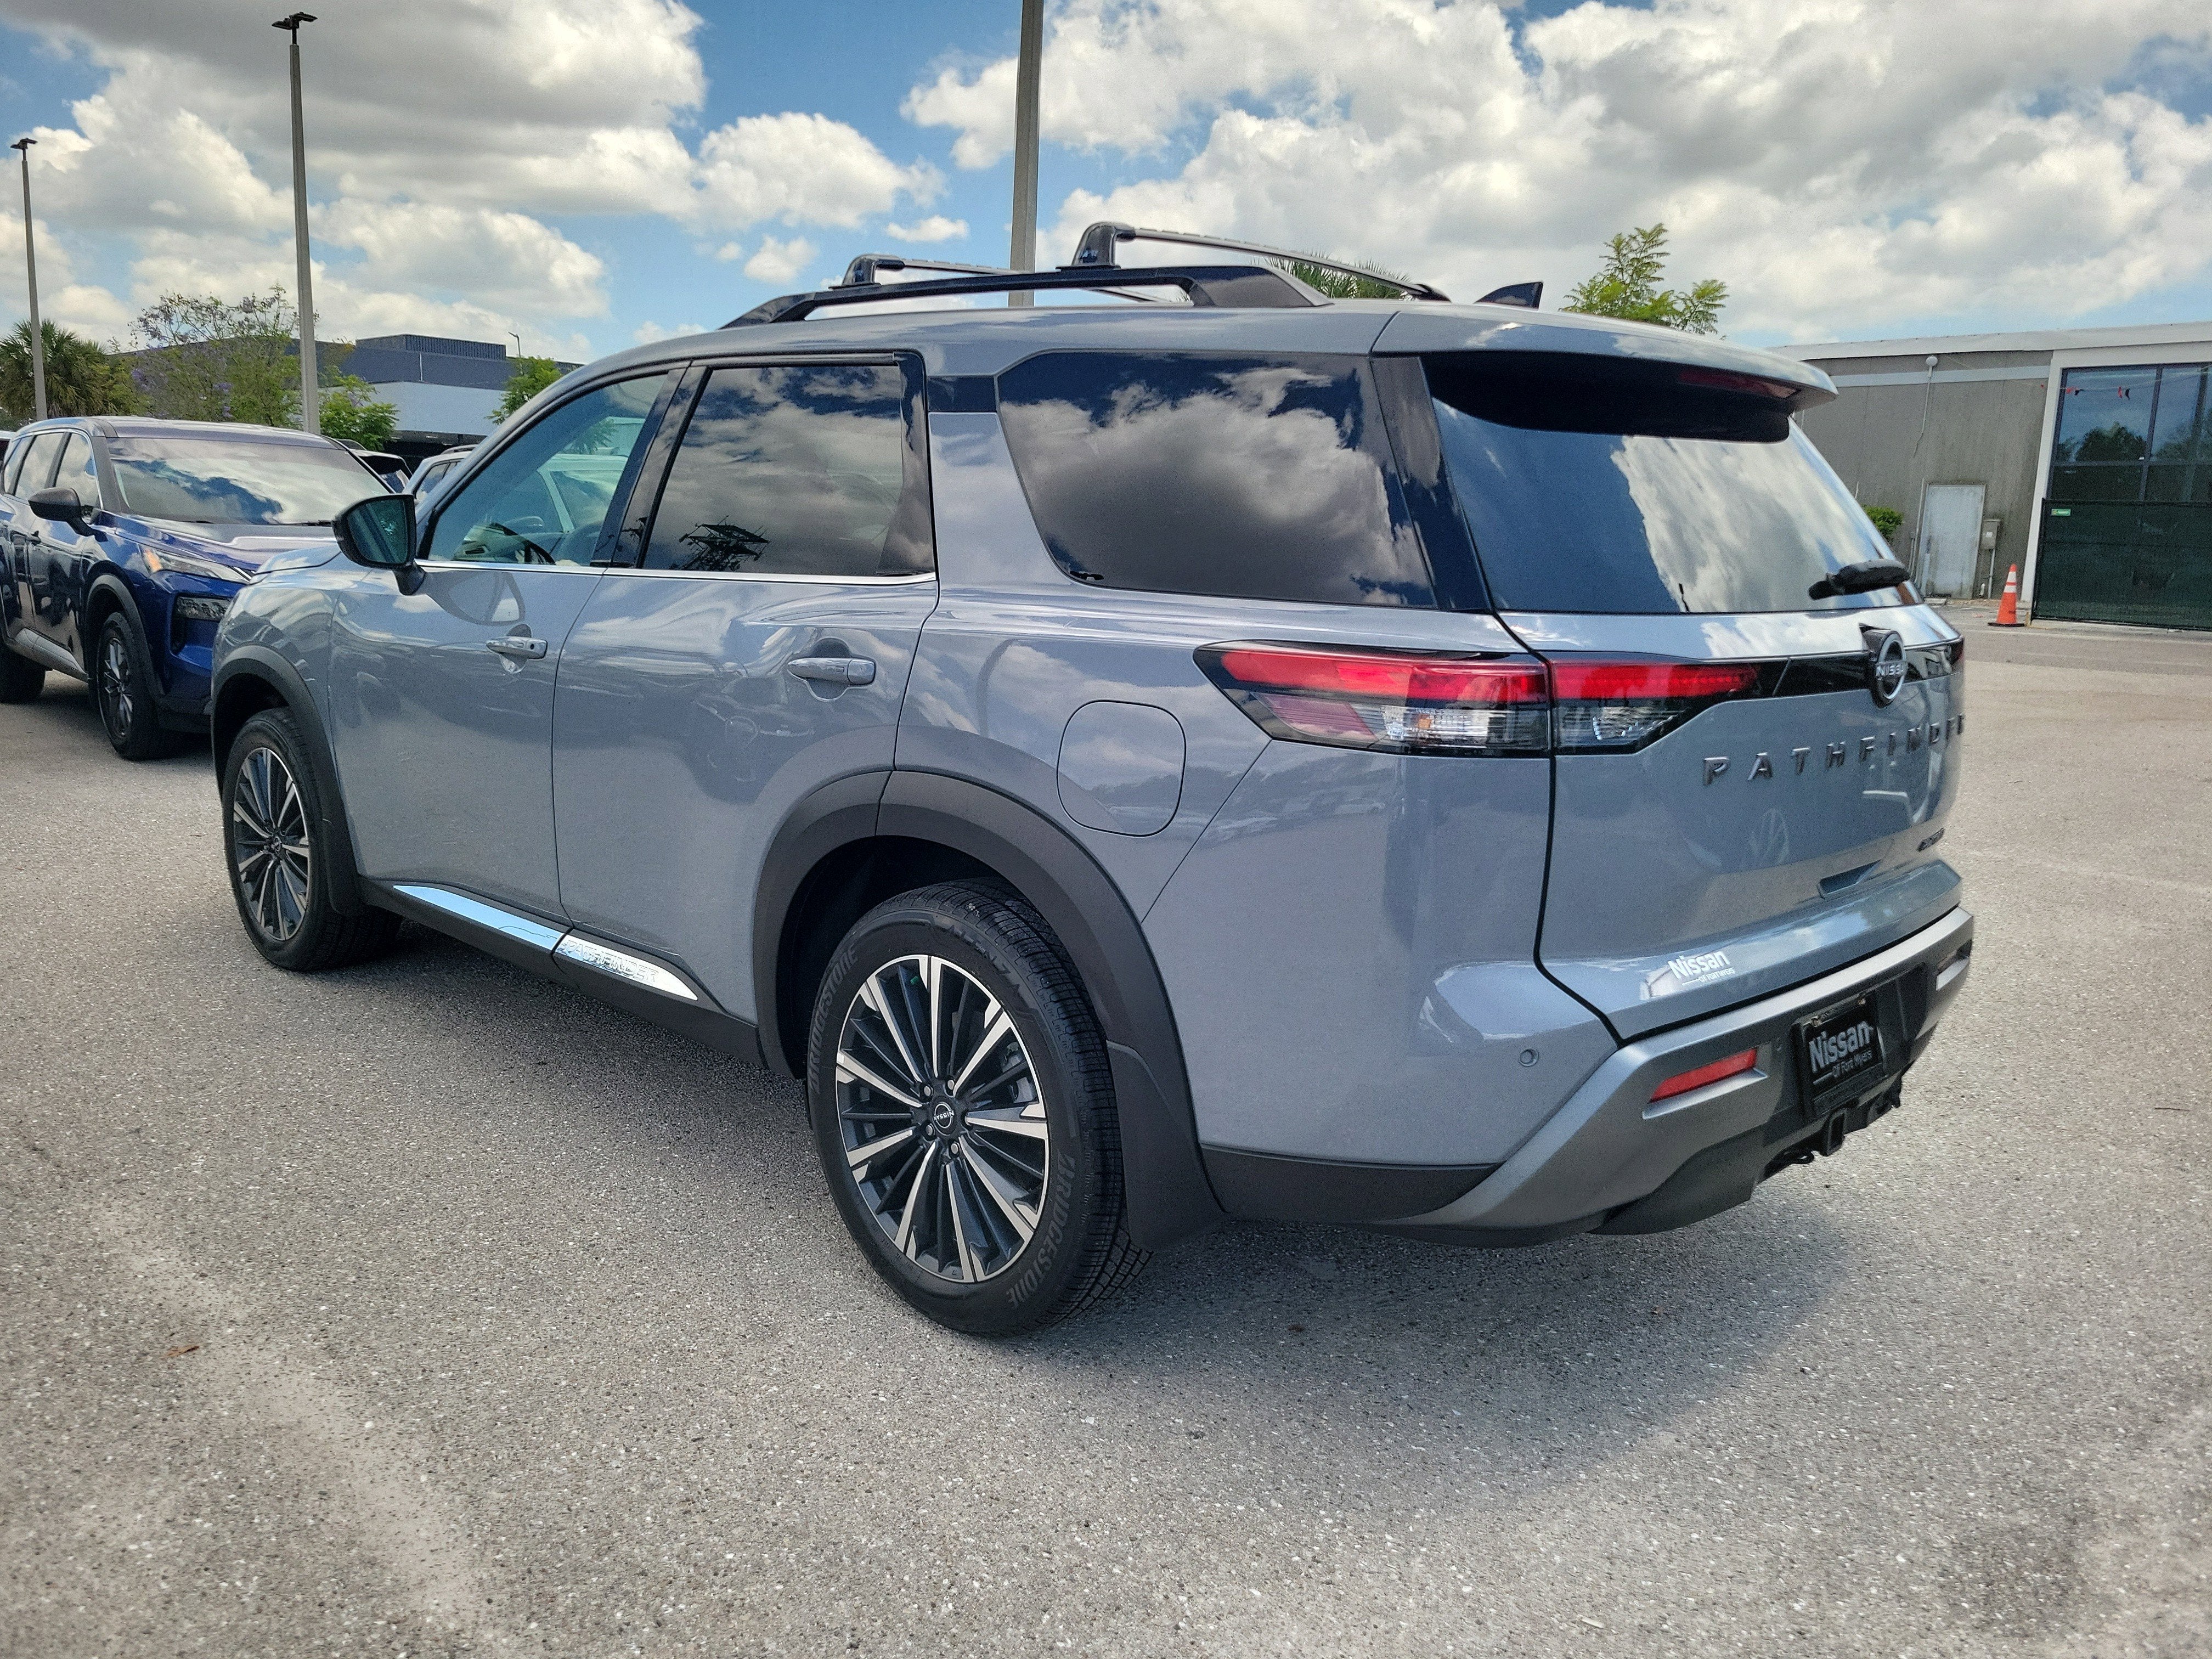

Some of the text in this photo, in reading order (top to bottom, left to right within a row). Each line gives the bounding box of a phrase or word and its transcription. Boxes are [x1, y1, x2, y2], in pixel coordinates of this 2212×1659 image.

[1876, 663, 1904, 676] NISS
[565, 940, 659, 983] PATHFINDER
[1668, 951, 1730, 980] Nissan
[808, 945, 858, 1094] BRIDGESTONE
[1809, 1021, 1871, 1074] Nissan
[933, 1109, 955, 1121] NISSAN
[1006, 1149, 1075, 1307] BRIDGESTONE
